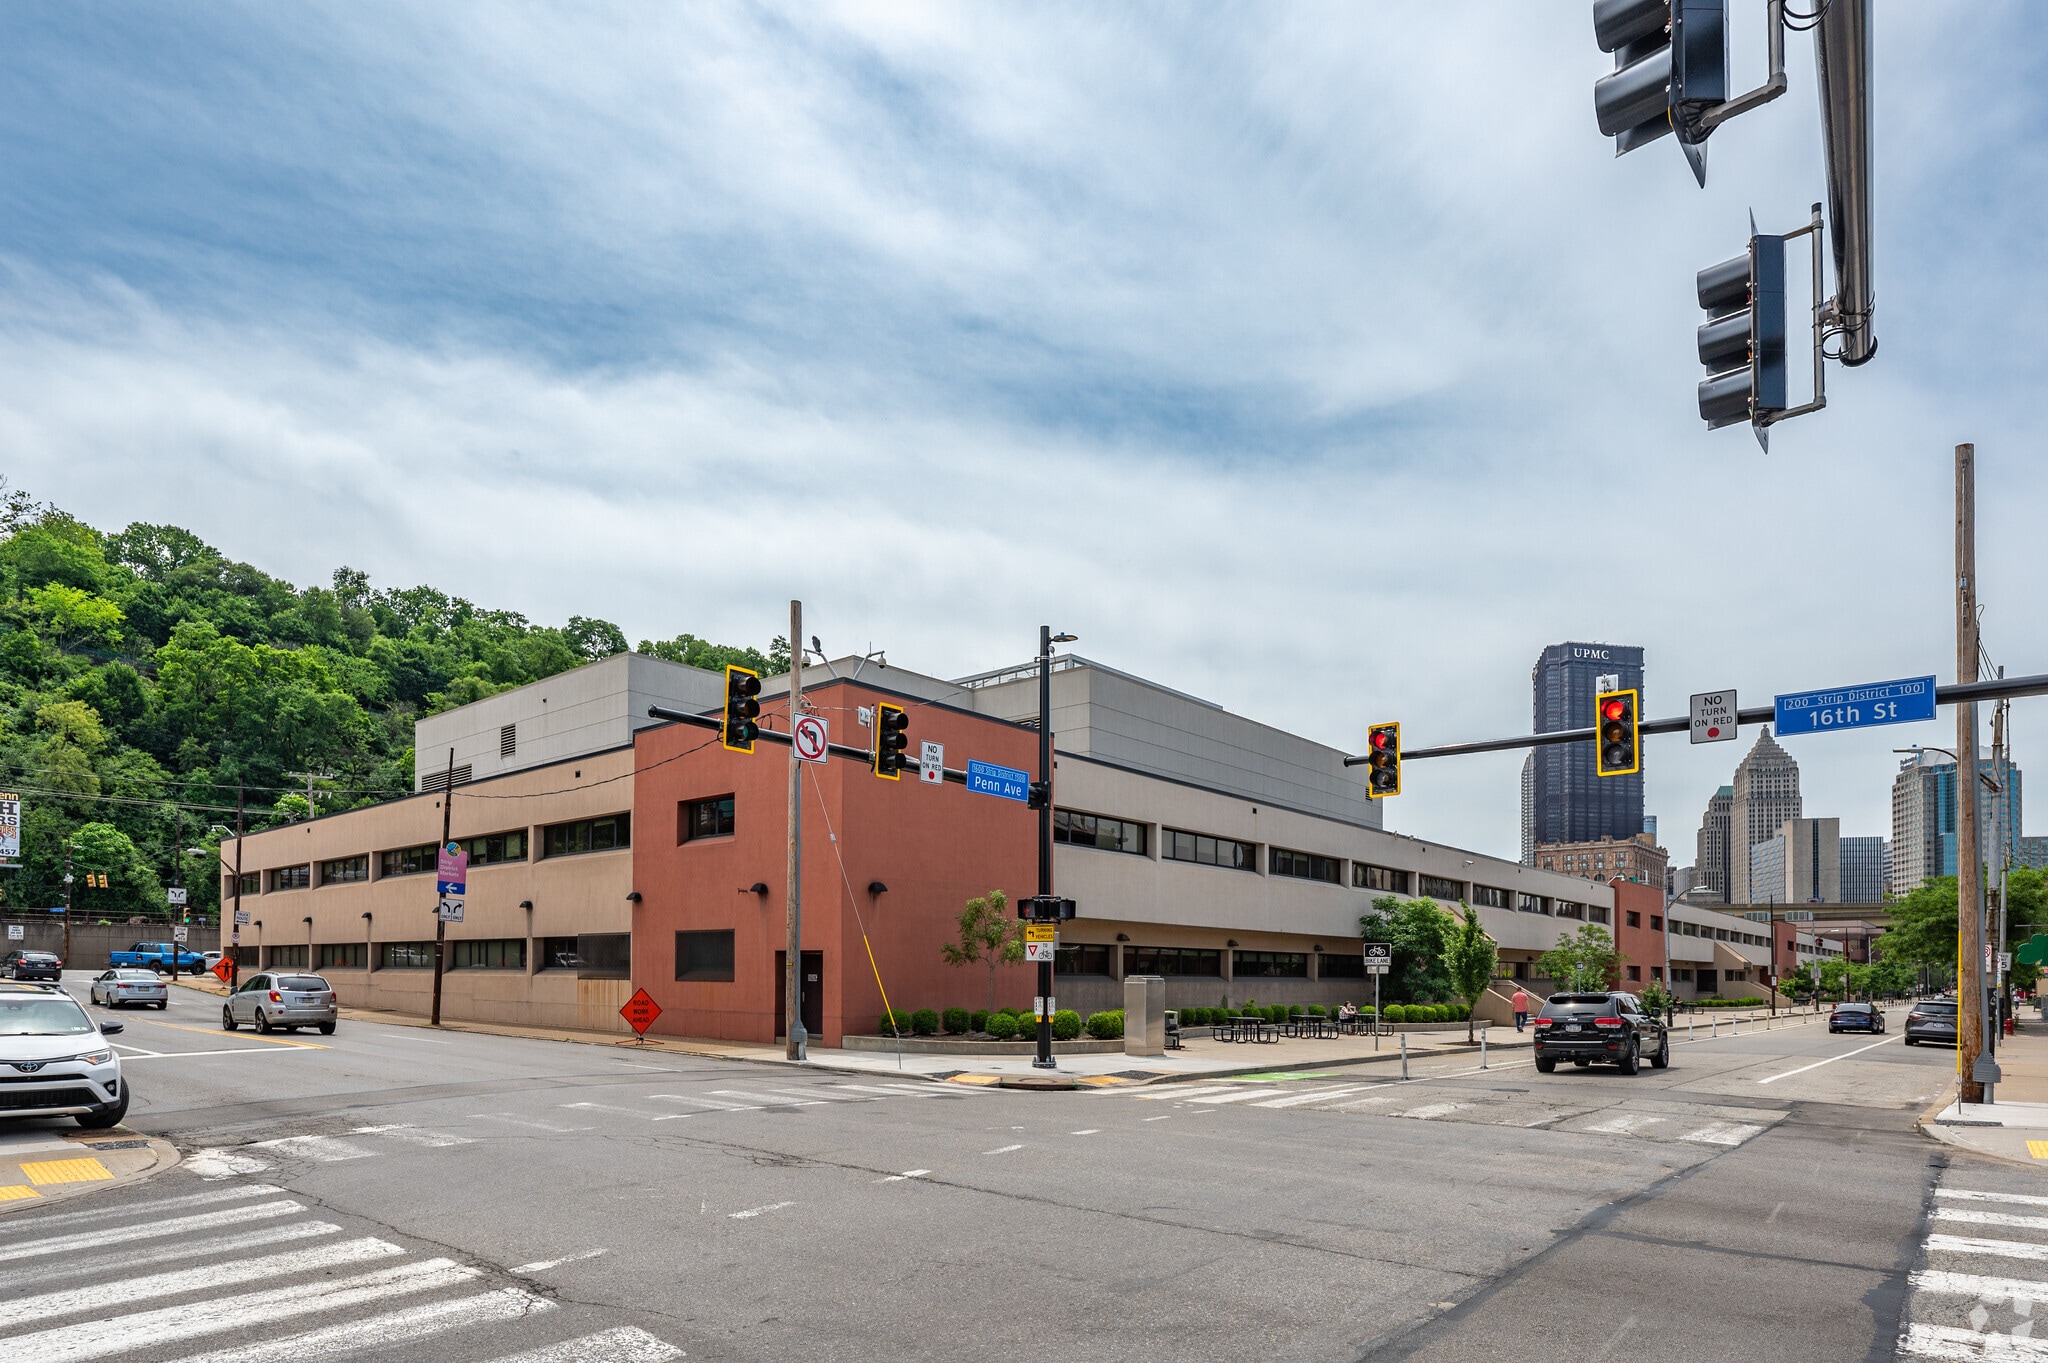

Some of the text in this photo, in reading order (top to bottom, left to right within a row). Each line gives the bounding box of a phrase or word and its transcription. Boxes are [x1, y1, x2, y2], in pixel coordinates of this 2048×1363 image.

[1573, 648, 1609, 660] UPMC
[1704, 695, 1722, 706] NO
[1788, 684, 1920, 709] 200 Strip District 100
[1700, 706, 1727, 717] TURN
[1809, 701, 1897, 727] 16th St
[1694, 716, 1733, 728] ON RED
[928, 745, 937, 753] NO
[925, 754, 940, 763] TURN
[931, 764, 942, 772] RED
[975, 776, 1022, 797] Penn Ave
[0, 792, 18, 800] enn
[0, 801, 17, 815] H
[0, 816, 17, 826] RS
